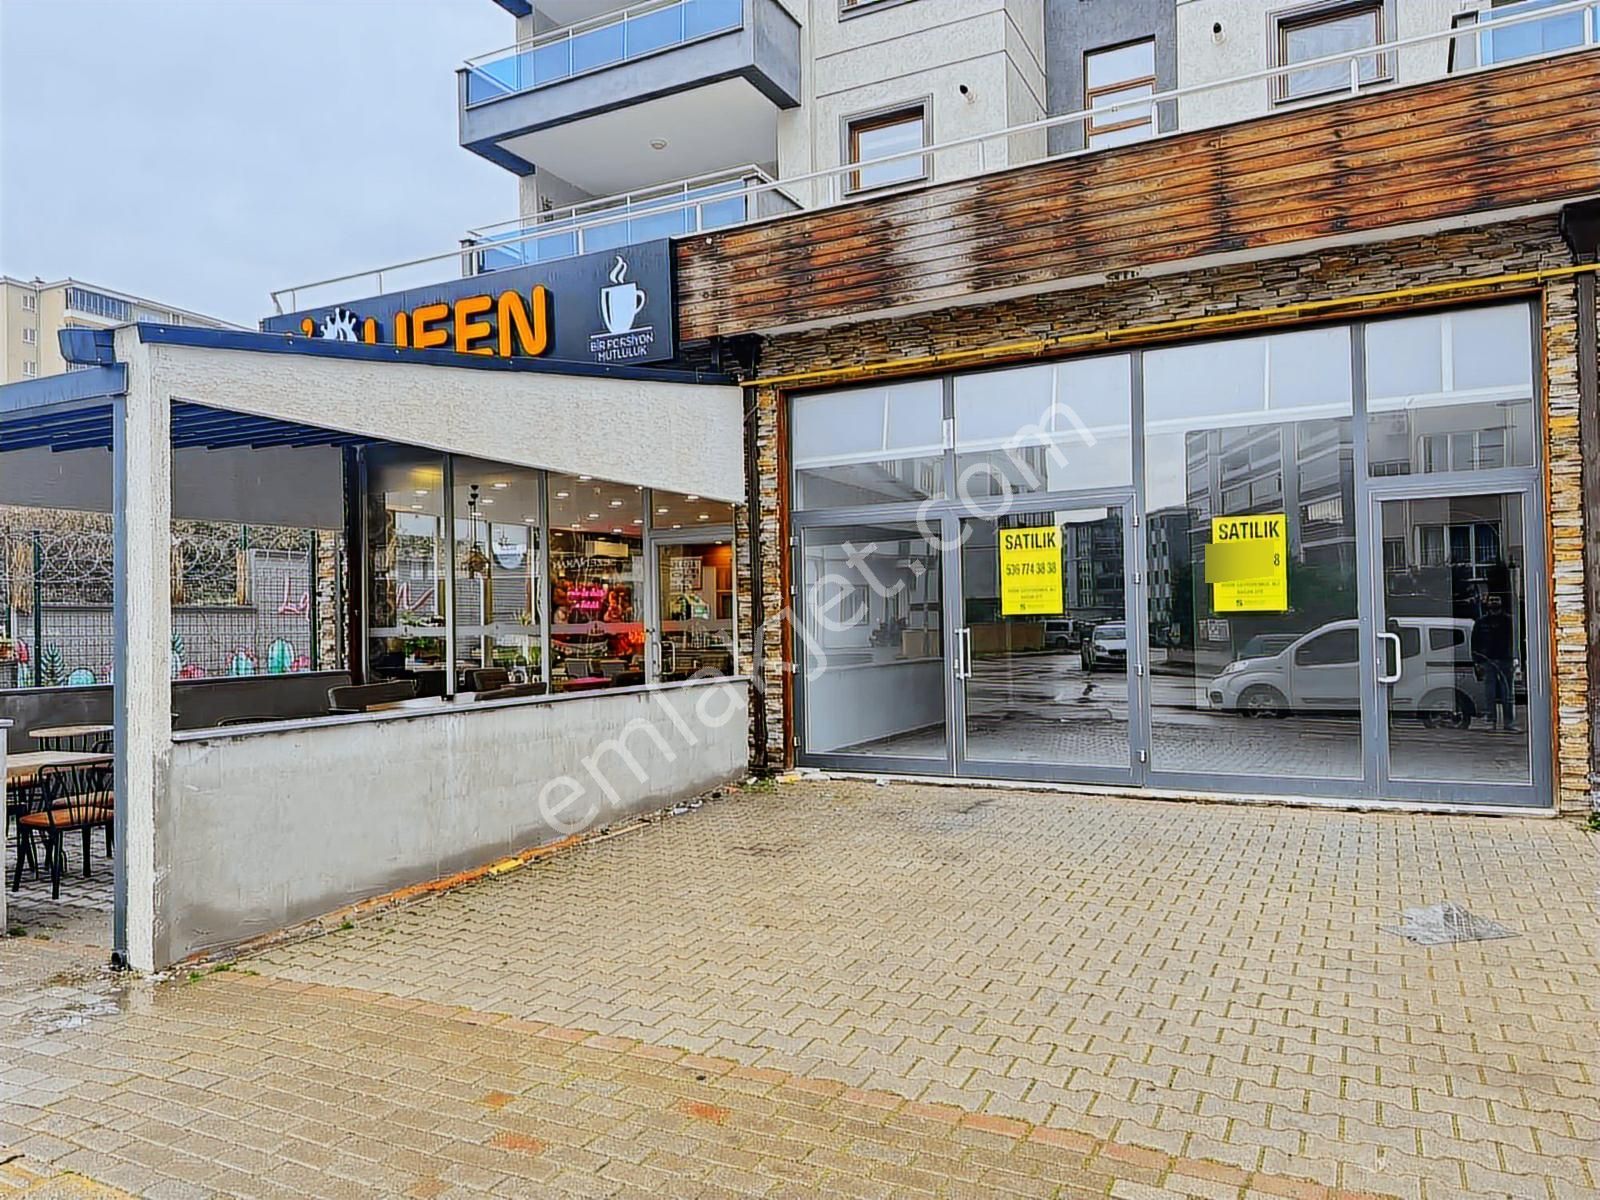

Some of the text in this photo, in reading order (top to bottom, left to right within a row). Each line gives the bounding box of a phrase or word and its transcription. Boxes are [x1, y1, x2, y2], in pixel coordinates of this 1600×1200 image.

[598, 345, 648, 361] MUTLULUK
[1218, 521, 1280, 540] SATILIK
[1005, 532, 1056, 550] SATILIK
